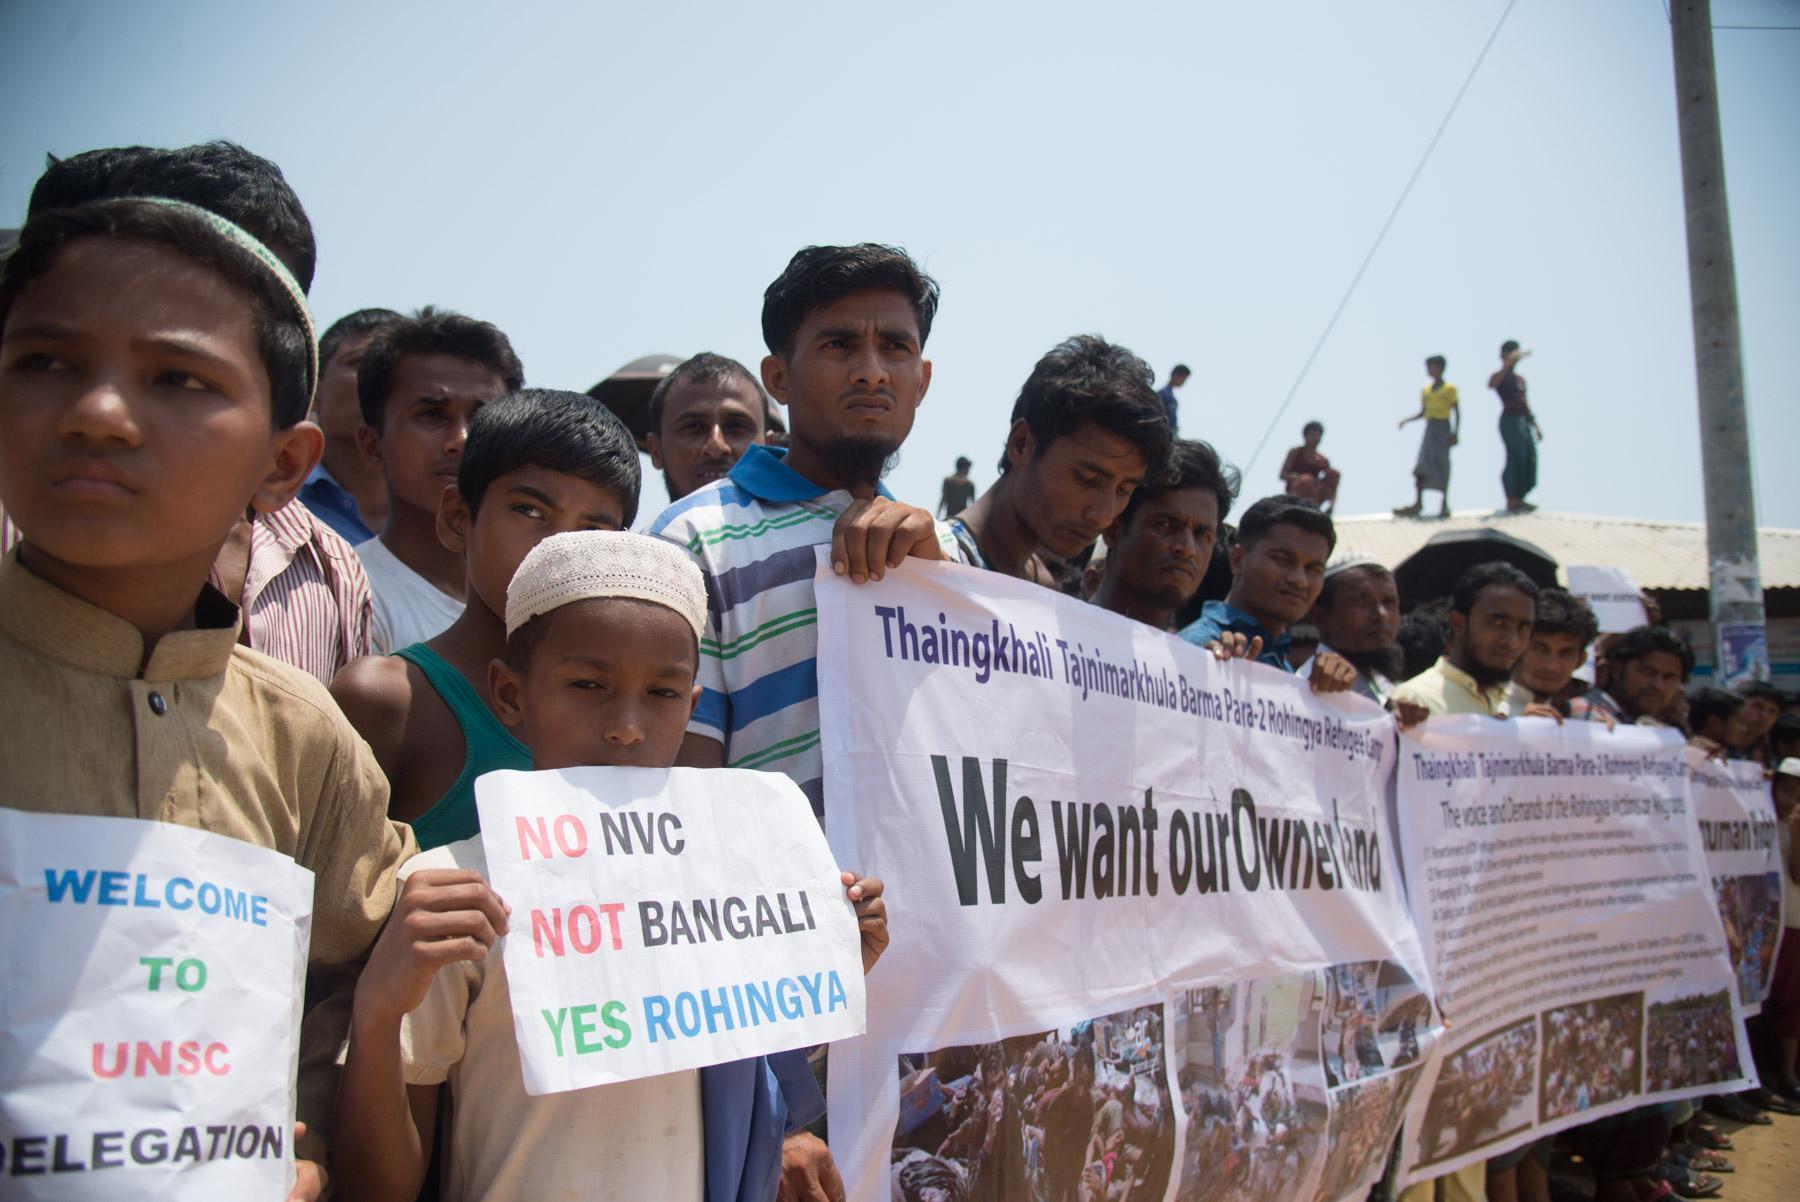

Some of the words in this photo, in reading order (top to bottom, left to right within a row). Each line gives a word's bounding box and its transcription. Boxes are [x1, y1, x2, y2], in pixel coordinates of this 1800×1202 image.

[874, 605, 1054, 684] Thaingkhali
[1055, 638, 1178, 710] Tajnimarkhula
[1178, 673, 1223, 722] Barma
[1223, 688, 1267, 731] Para-2
[1267, 700, 1322, 751] Rohingya
[515, 813, 588, 861] NO
[599, 811, 686, 856] NVC
[930, 754, 1043, 907] We
[1051, 786, 1159, 900] want
[44, 868, 268, 927] WELCOME
[530, 902, 625, 959] NOT
[638, 890, 817, 948] BANGALI
[139, 957, 208, 992] TO
[541, 1000, 632, 1058] YES
[642, 969, 848, 1044] ROHINGYA
[91, 1040, 231, 1079] UNSC
[0, 1124, 284, 1177] ELEGATION
